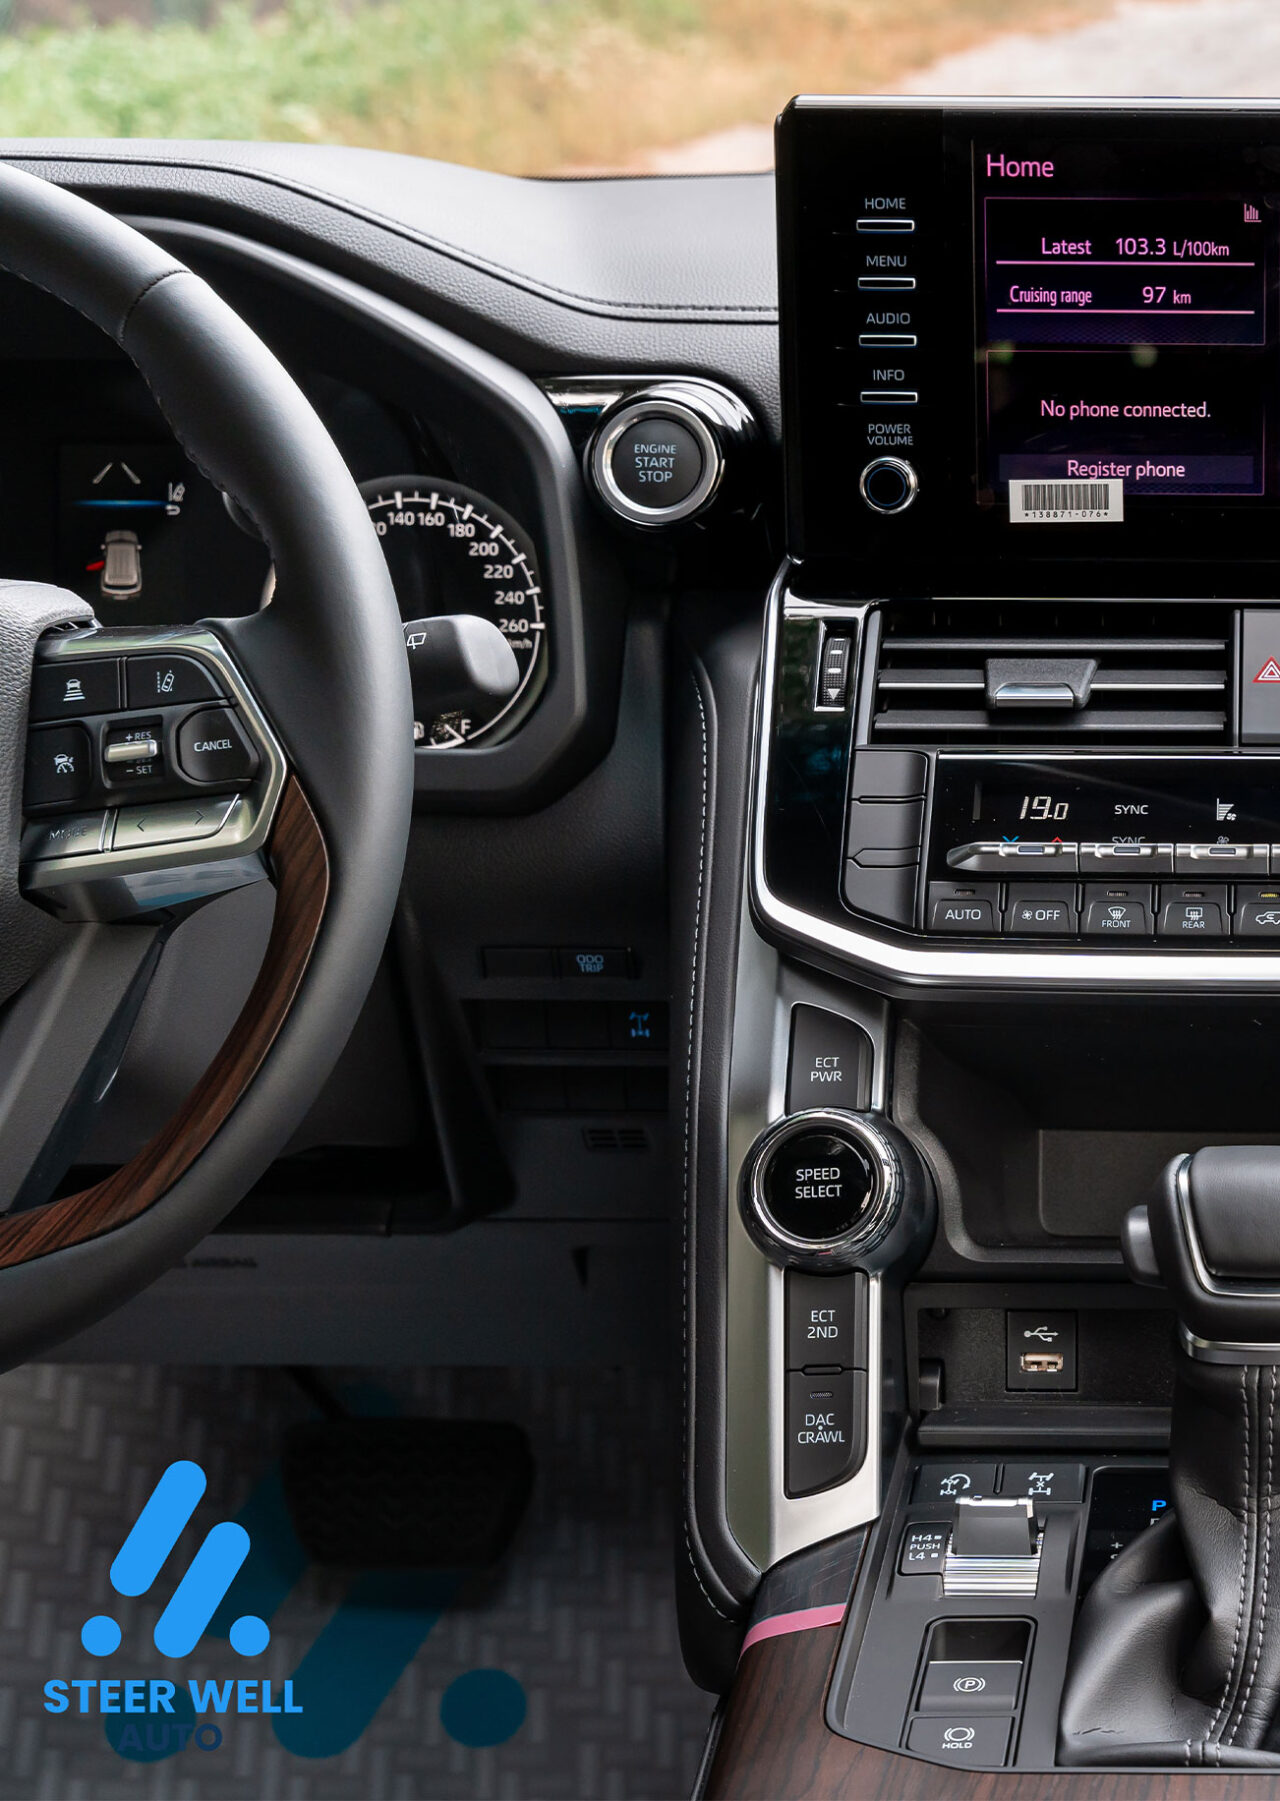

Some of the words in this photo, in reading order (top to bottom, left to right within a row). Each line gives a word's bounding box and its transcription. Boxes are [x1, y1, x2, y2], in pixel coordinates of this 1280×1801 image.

[987, 154, 1054, 178] Home
[864, 197, 906, 210] HOME
[1041, 237, 1092, 255] Latest
[1115, 237, 1166, 255] 103.3
[1173, 239, 1230, 258] L/100km
[866, 255, 907, 267] MENU
[1009, 285, 1057, 306] Cruising
[1060, 289, 1092, 307] range
[1142, 286, 1166, 303] 97
[1173, 290, 1191, 304] km
[866, 312, 911, 324] AUDIO
[872, 369, 905, 381] INFO
[1041, 400, 1065, 418] No
[1069, 400, 1119, 420] phone
[1123, 401, 1211, 418] connected.
[868, 423, 911, 434] POWER
[867, 435, 914, 446] VOLUME
[634, 443, 677, 455] ENGINE
[635, 456, 675, 469] START
[1067, 459, 1131, 480] Register
[1136, 461, 1186, 480] phone
[638, 470, 673, 483] STOP
[387, 511, 415, 526] 140
[417, 512, 445, 527] 160
[447, 523, 475, 538] 180
[468, 541, 499, 557] 200
[483, 564, 513, 579] 220
[494, 590, 525, 605] 240
[499, 618, 528, 633] 260
[461, 718, 472, 735] F
[193, 738, 233, 752] CANCEL
[1019, 795, 1069, 820] 19.0
[1114, 804, 1149, 815] SYNC
[945, 908, 981, 921] AUTO
[1035, 909, 1061, 921] OFF
[1101, 919, 1131, 929] FRONT
[1182, 919, 1205, 929] REAR
[579, 963, 604, 974] TRIP
[815, 1056, 840, 1068] ECT
[810, 1070, 843, 1082] PWR
[796, 1167, 841, 1182] SPEED
[794, 1184, 843, 1199] SELECT
[810, 1309, 836, 1323] ECT
[807, 1325, 839, 1339] 2ND
[804, 1413, 835, 1427] DAC
[797, 1430, 846, 1444] CRAWL
[1151, 1499, 1167, 1512] P
[911, 1533, 932, 1542] H4
[909, 1542, 941, 1550] PUSH
[908, 1551, 925, 1561] L4
[942, 1741, 973, 1749] HOLD
